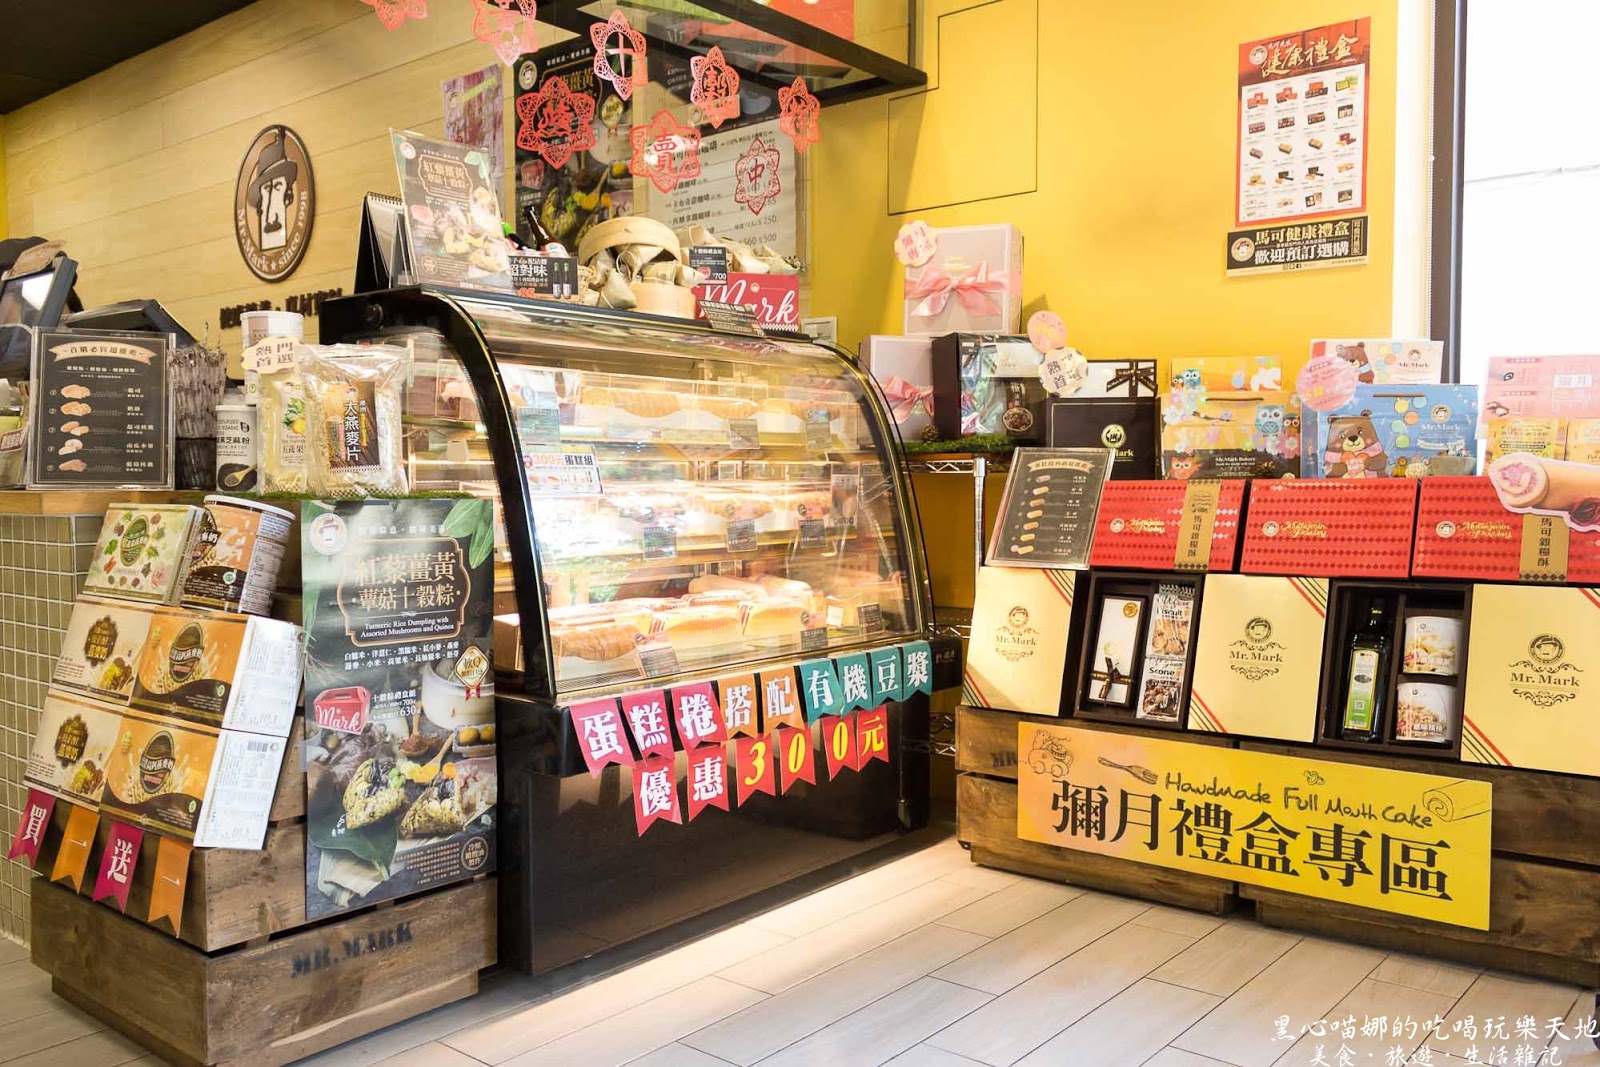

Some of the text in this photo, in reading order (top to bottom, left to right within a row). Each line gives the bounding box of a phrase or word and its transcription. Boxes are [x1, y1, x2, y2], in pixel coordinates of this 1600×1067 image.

[748, 157, 766, 193] 中
[1255, 221, 1350, 246] 馬可健康禮盒
[1255, 241, 1350, 265] 歡迎預訂選購
[344, 400, 362, 462] 大燕麥片
[355, 551, 456, 587] 紅藜薑黃
[360, 629, 387, 638] Assorted
[388, 626, 422, 635] Mushrooms
[434, 623, 454, 632] Quinoa
[365, 622, 392, 631] Turmeric
[407, 618, 435, 627] Dumpling
[1251, 651, 1283, 662] Mark
[1149, 667, 1175, 676] Scone
[1511, 672, 1580, 687] Mr. Mark
[315, 704, 361, 731] Mark
[1165, 772, 1272, 804] Handmade
[1283, 786, 1319, 811] Full
[1381, 804, 1434, 828] Cake
[1051, 778, 1454, 902] 彌月禮盒專區
